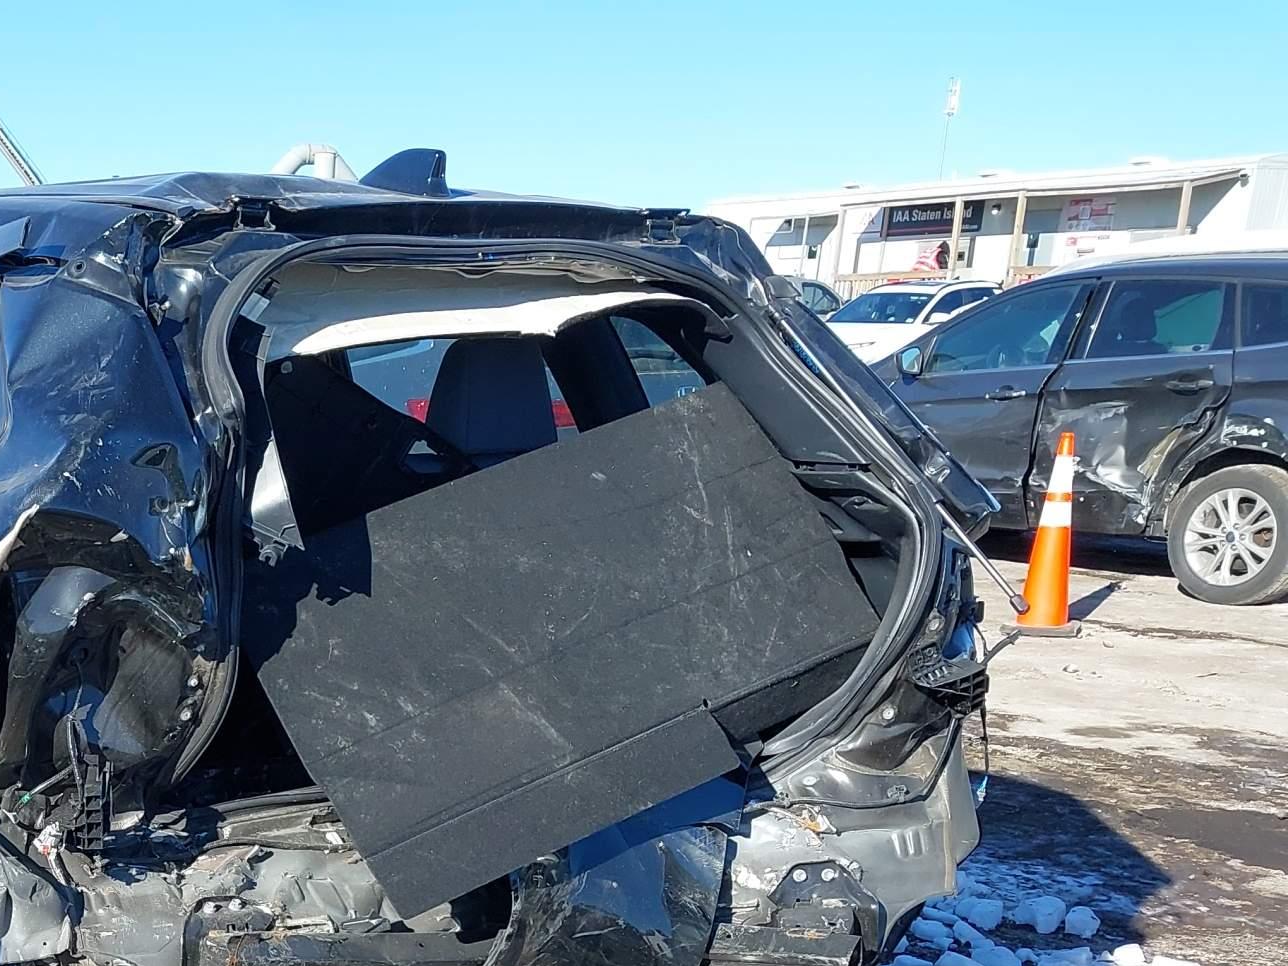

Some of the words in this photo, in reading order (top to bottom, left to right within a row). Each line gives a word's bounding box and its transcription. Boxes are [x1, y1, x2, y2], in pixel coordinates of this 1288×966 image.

[892, 210, 910, 223] IAA
[912, 209, 941, 221] Staten
[943, 205, 973, 219] Islnd
